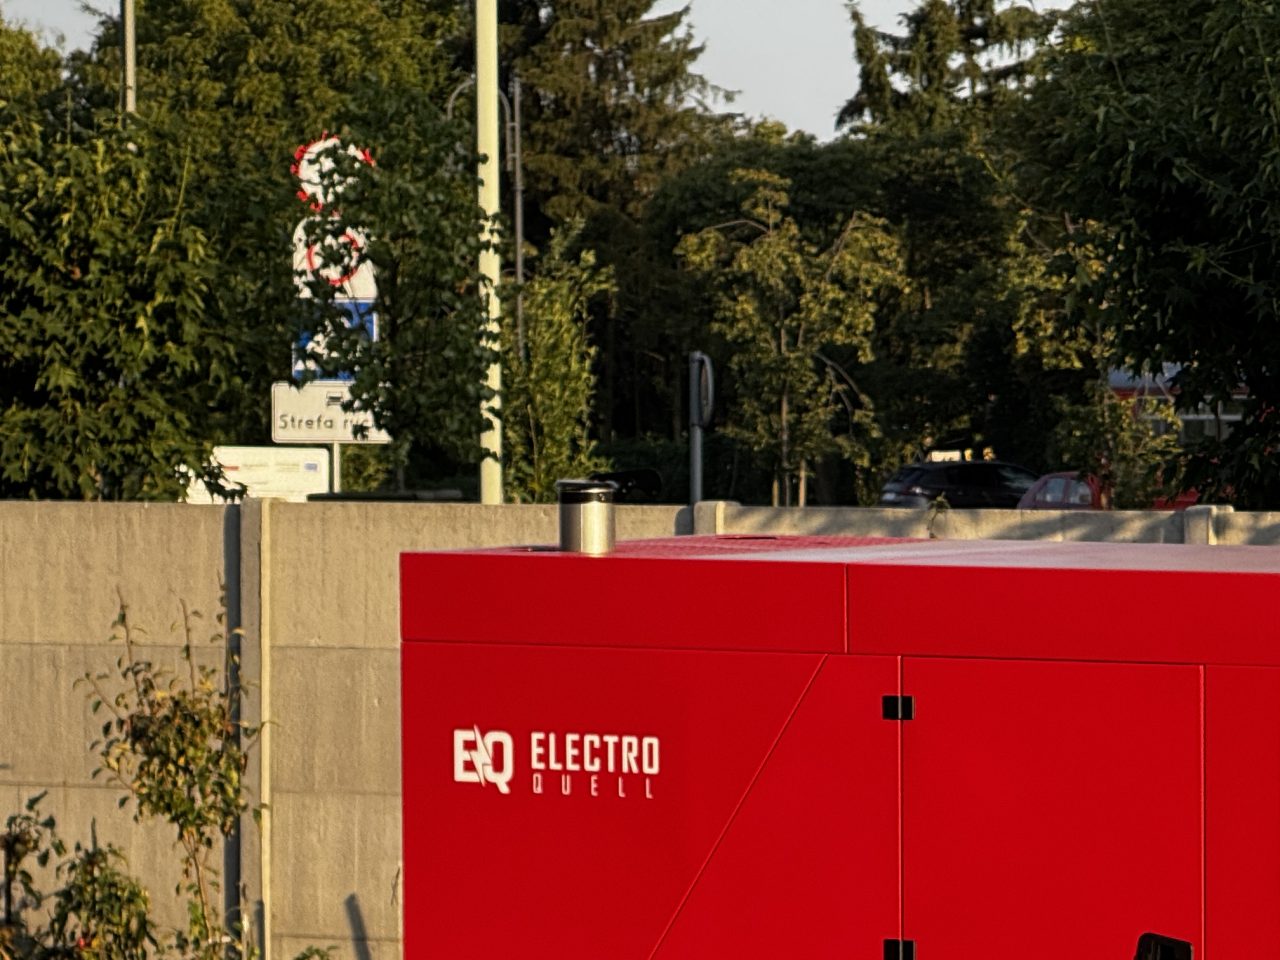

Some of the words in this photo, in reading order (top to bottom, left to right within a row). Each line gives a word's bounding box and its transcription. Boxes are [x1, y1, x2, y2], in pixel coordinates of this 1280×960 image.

[279, 414, 334, 430] Strefa
[530, 731, 660, 775] ELECTRO
[532, 772, 654, 799] QUELL
